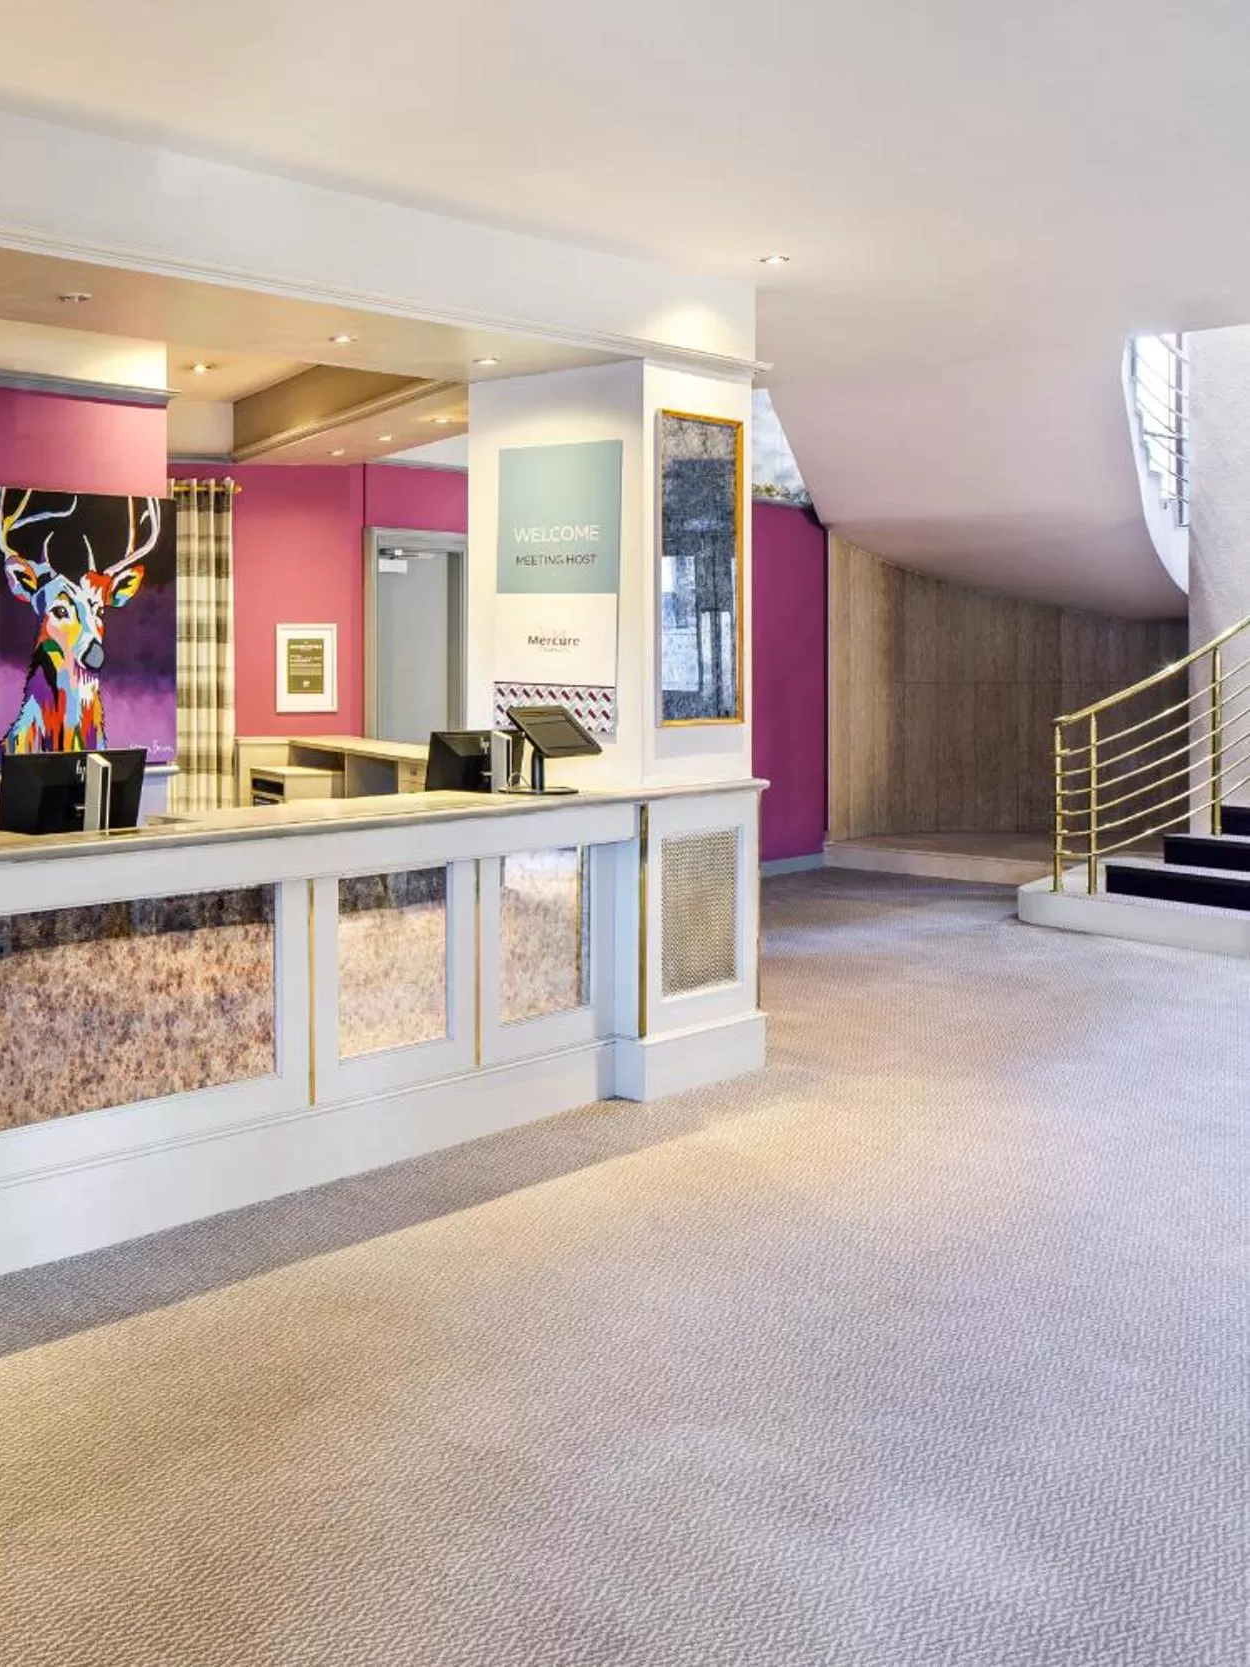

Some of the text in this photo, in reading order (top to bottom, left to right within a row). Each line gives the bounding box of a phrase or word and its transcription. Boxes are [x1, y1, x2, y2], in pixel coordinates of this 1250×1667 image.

[513, 524, 600, 542] WELCOME
[516, 553, 598, 566] MEETING HOST
[528, 635, 580, 646] Mercure
